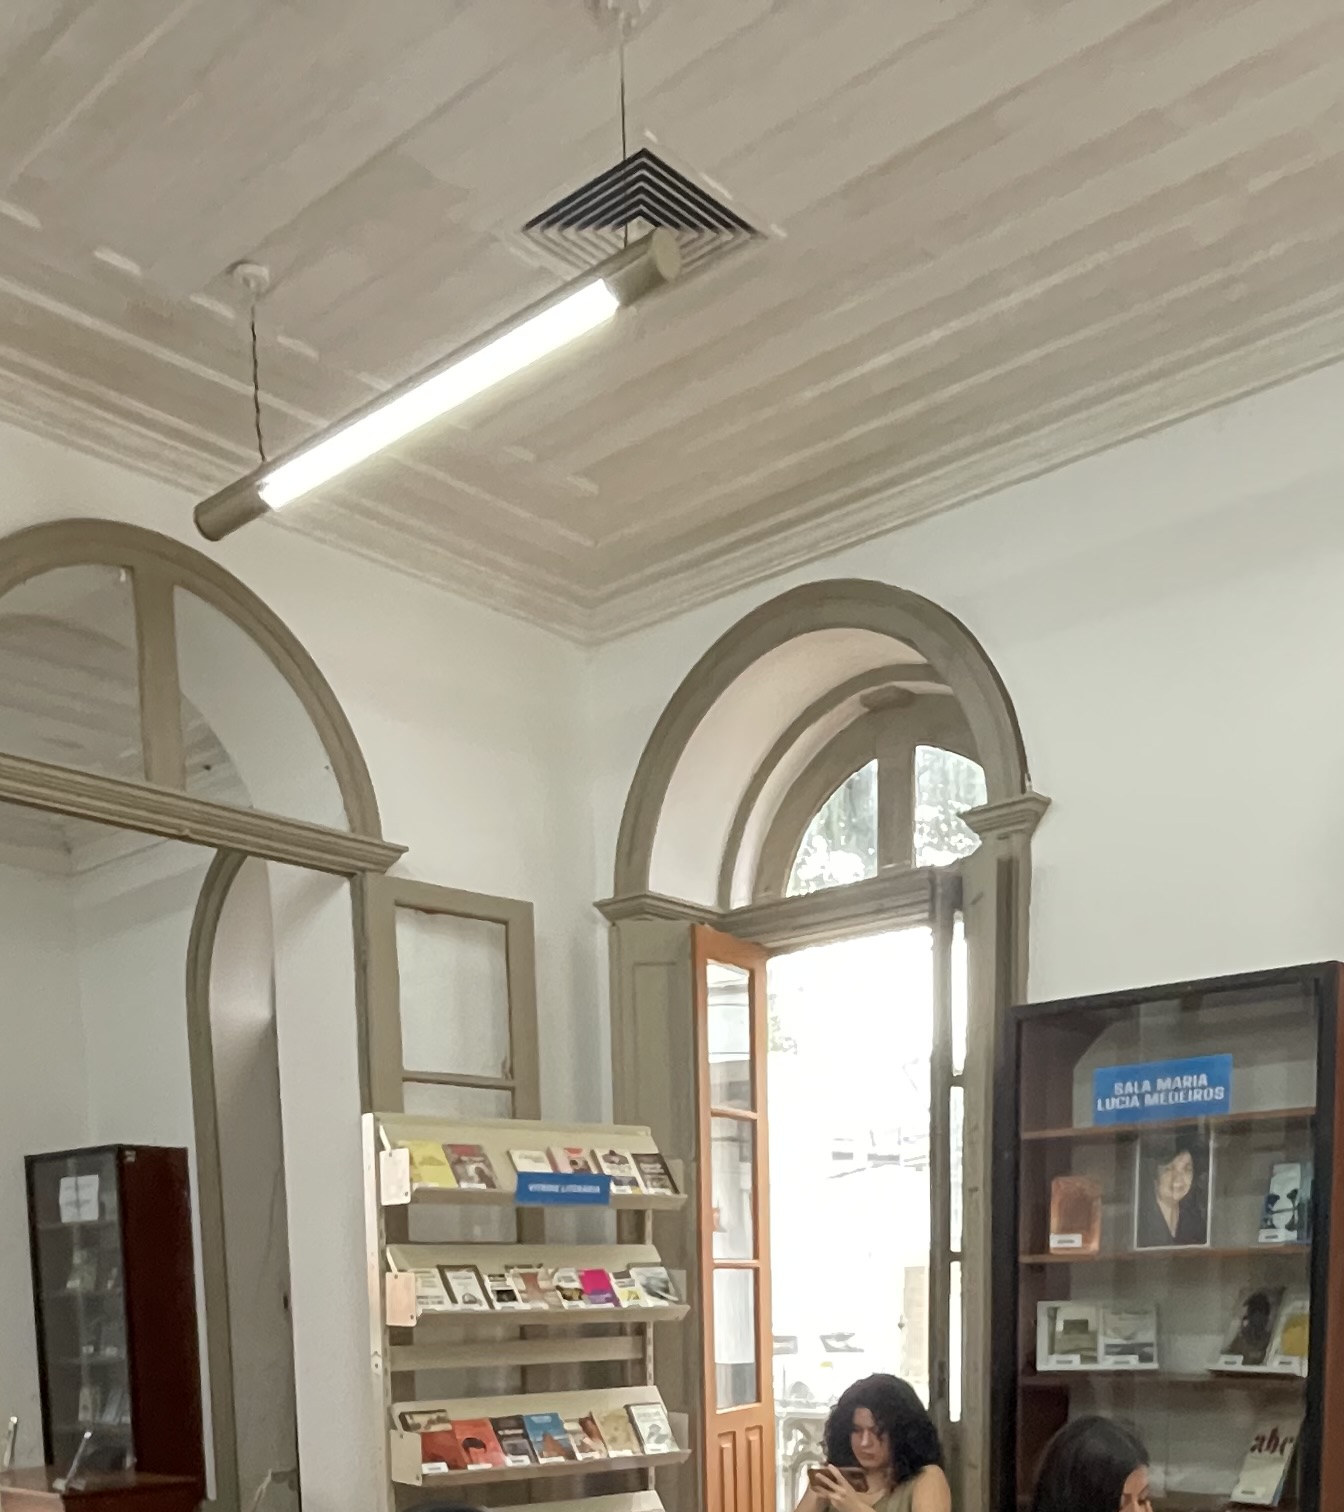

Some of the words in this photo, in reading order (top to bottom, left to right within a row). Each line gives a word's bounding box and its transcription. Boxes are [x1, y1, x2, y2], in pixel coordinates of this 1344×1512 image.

[1113, 1080, 1152, 1096] SALA
[1156, 1073, 1209, 1091] MARIA
[1144, 1086, 1226, 1107] MEDEIROS
